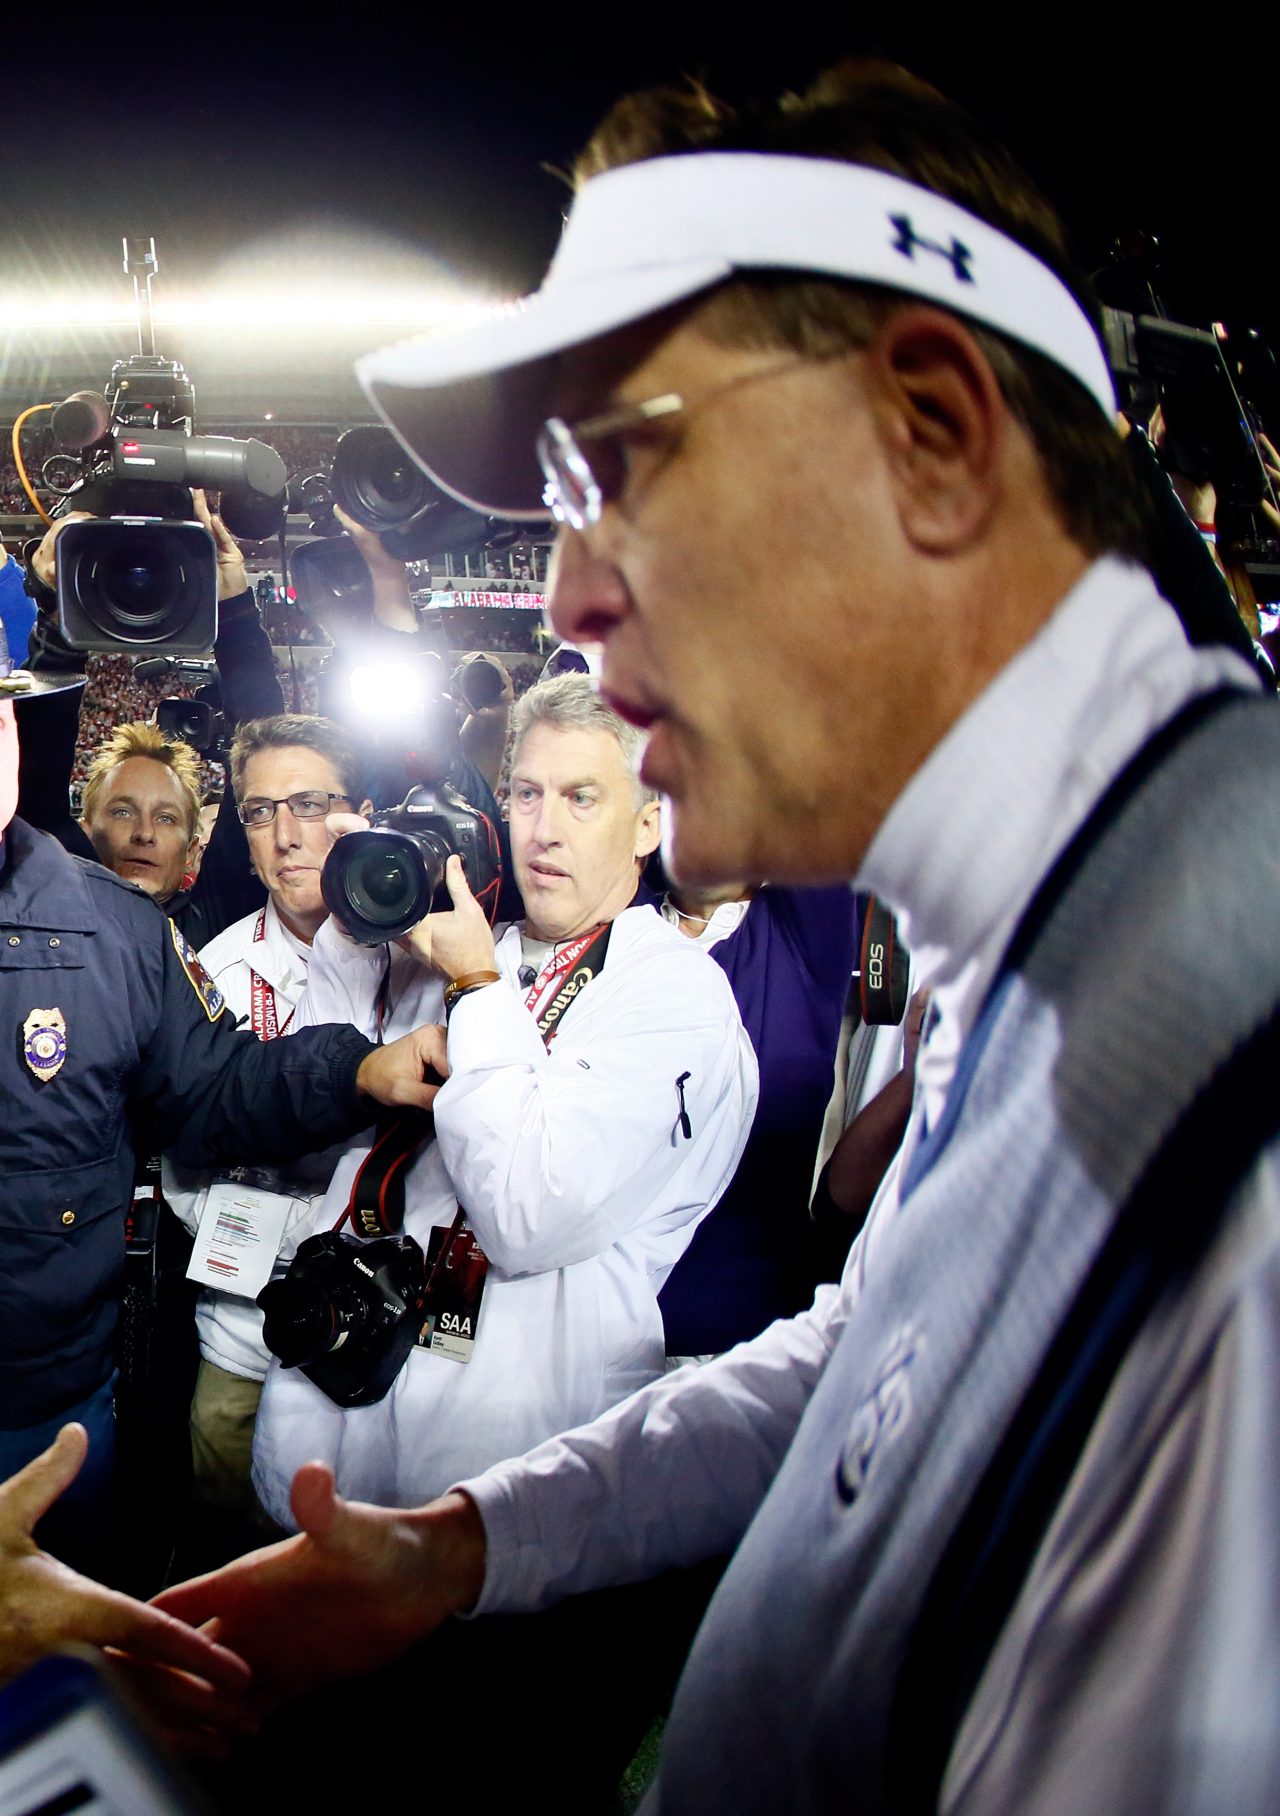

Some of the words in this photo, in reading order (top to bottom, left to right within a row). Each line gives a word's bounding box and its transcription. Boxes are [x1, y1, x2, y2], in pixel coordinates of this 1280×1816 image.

[407, 804, 434, 813] Canon
[869, 944, 884, 989] EOS
[538, 967, 593, 1035] Canon
[353, 1258, 375, 1278] Canon
[440, 1312, 472, 1335] SAA
